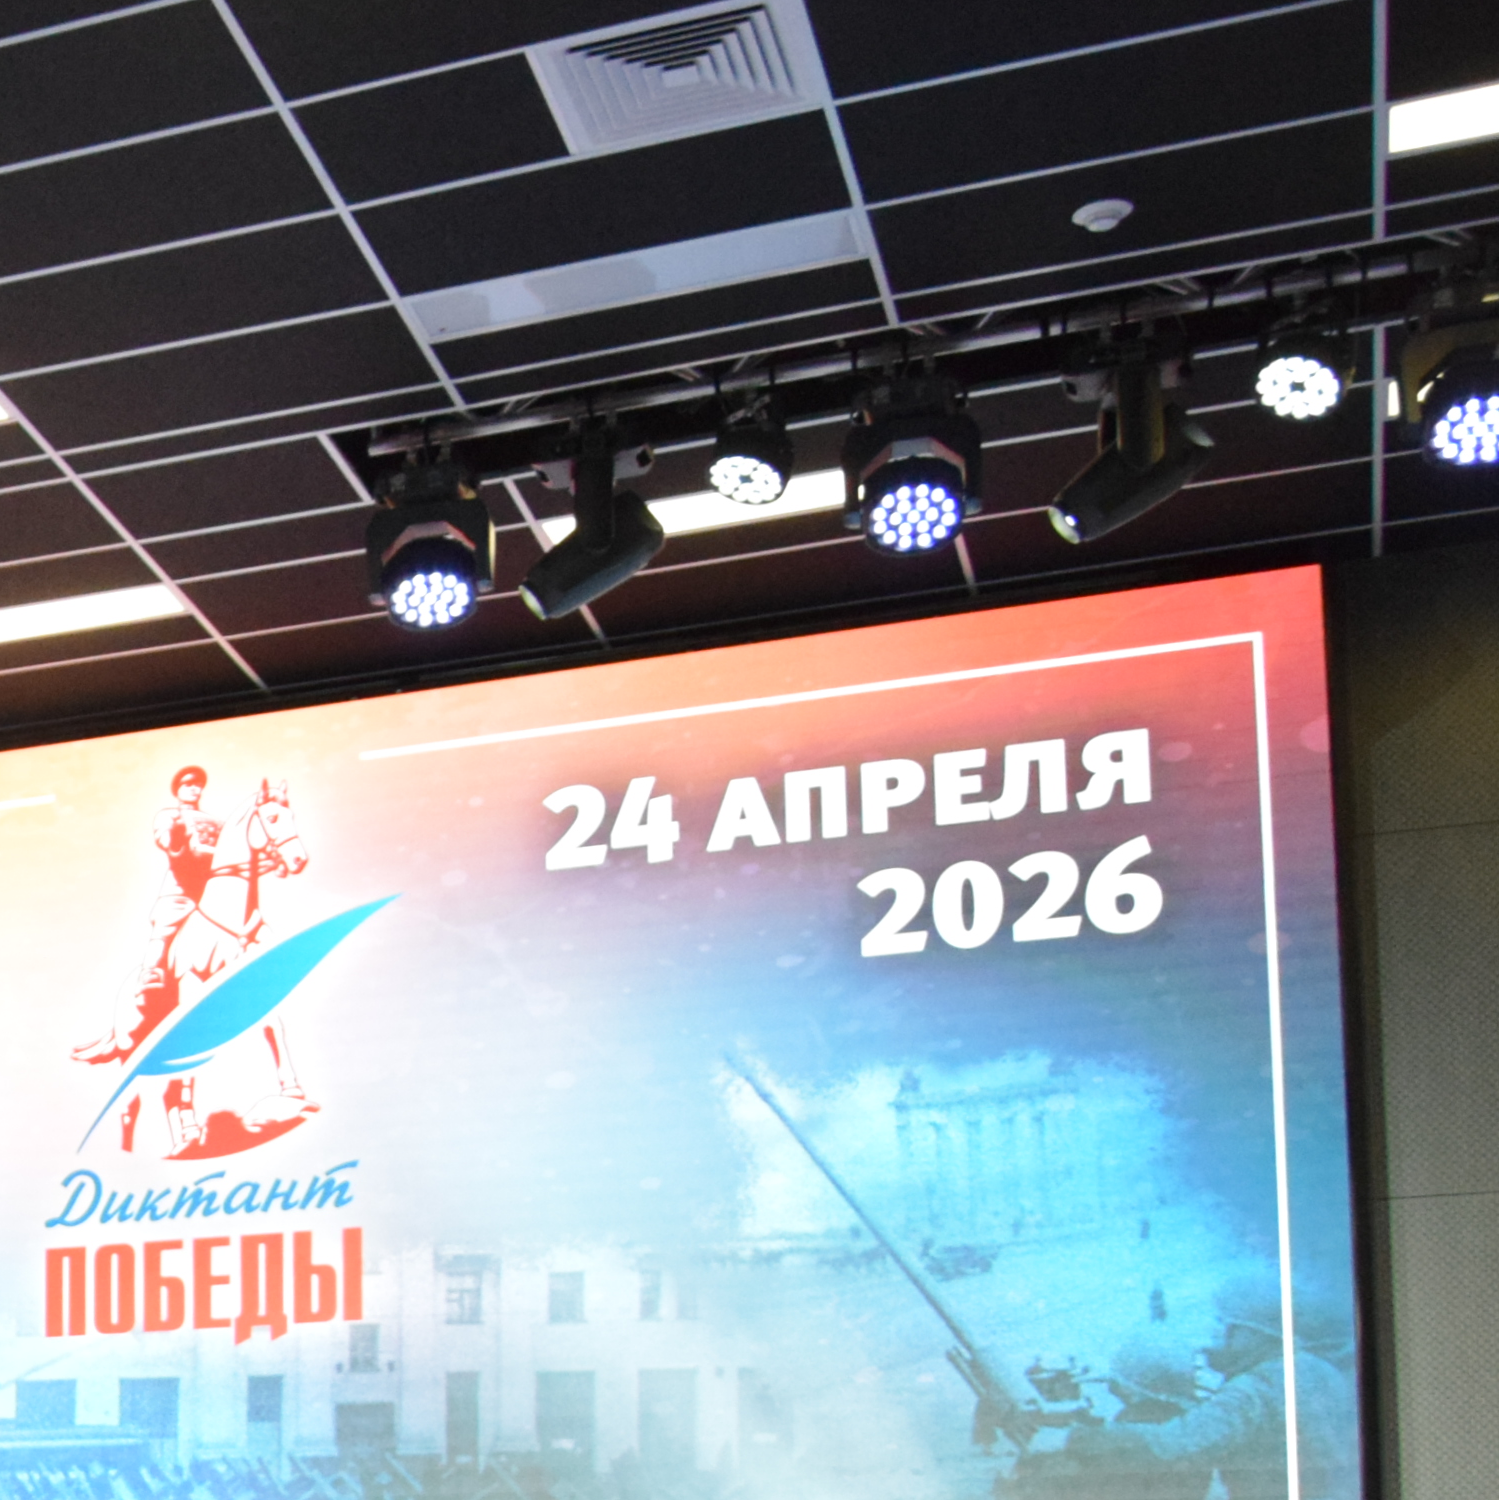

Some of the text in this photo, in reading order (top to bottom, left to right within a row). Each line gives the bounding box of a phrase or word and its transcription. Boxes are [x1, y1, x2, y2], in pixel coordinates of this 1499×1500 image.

[542, 728, 1152, 872] 24 АПРЕЛЯ
[856, 834, 1164, 958] 2026
[44, 1159, 360, 1229] Диктант
[45, 1226, 363, 1346] ПОБЕДЫ
